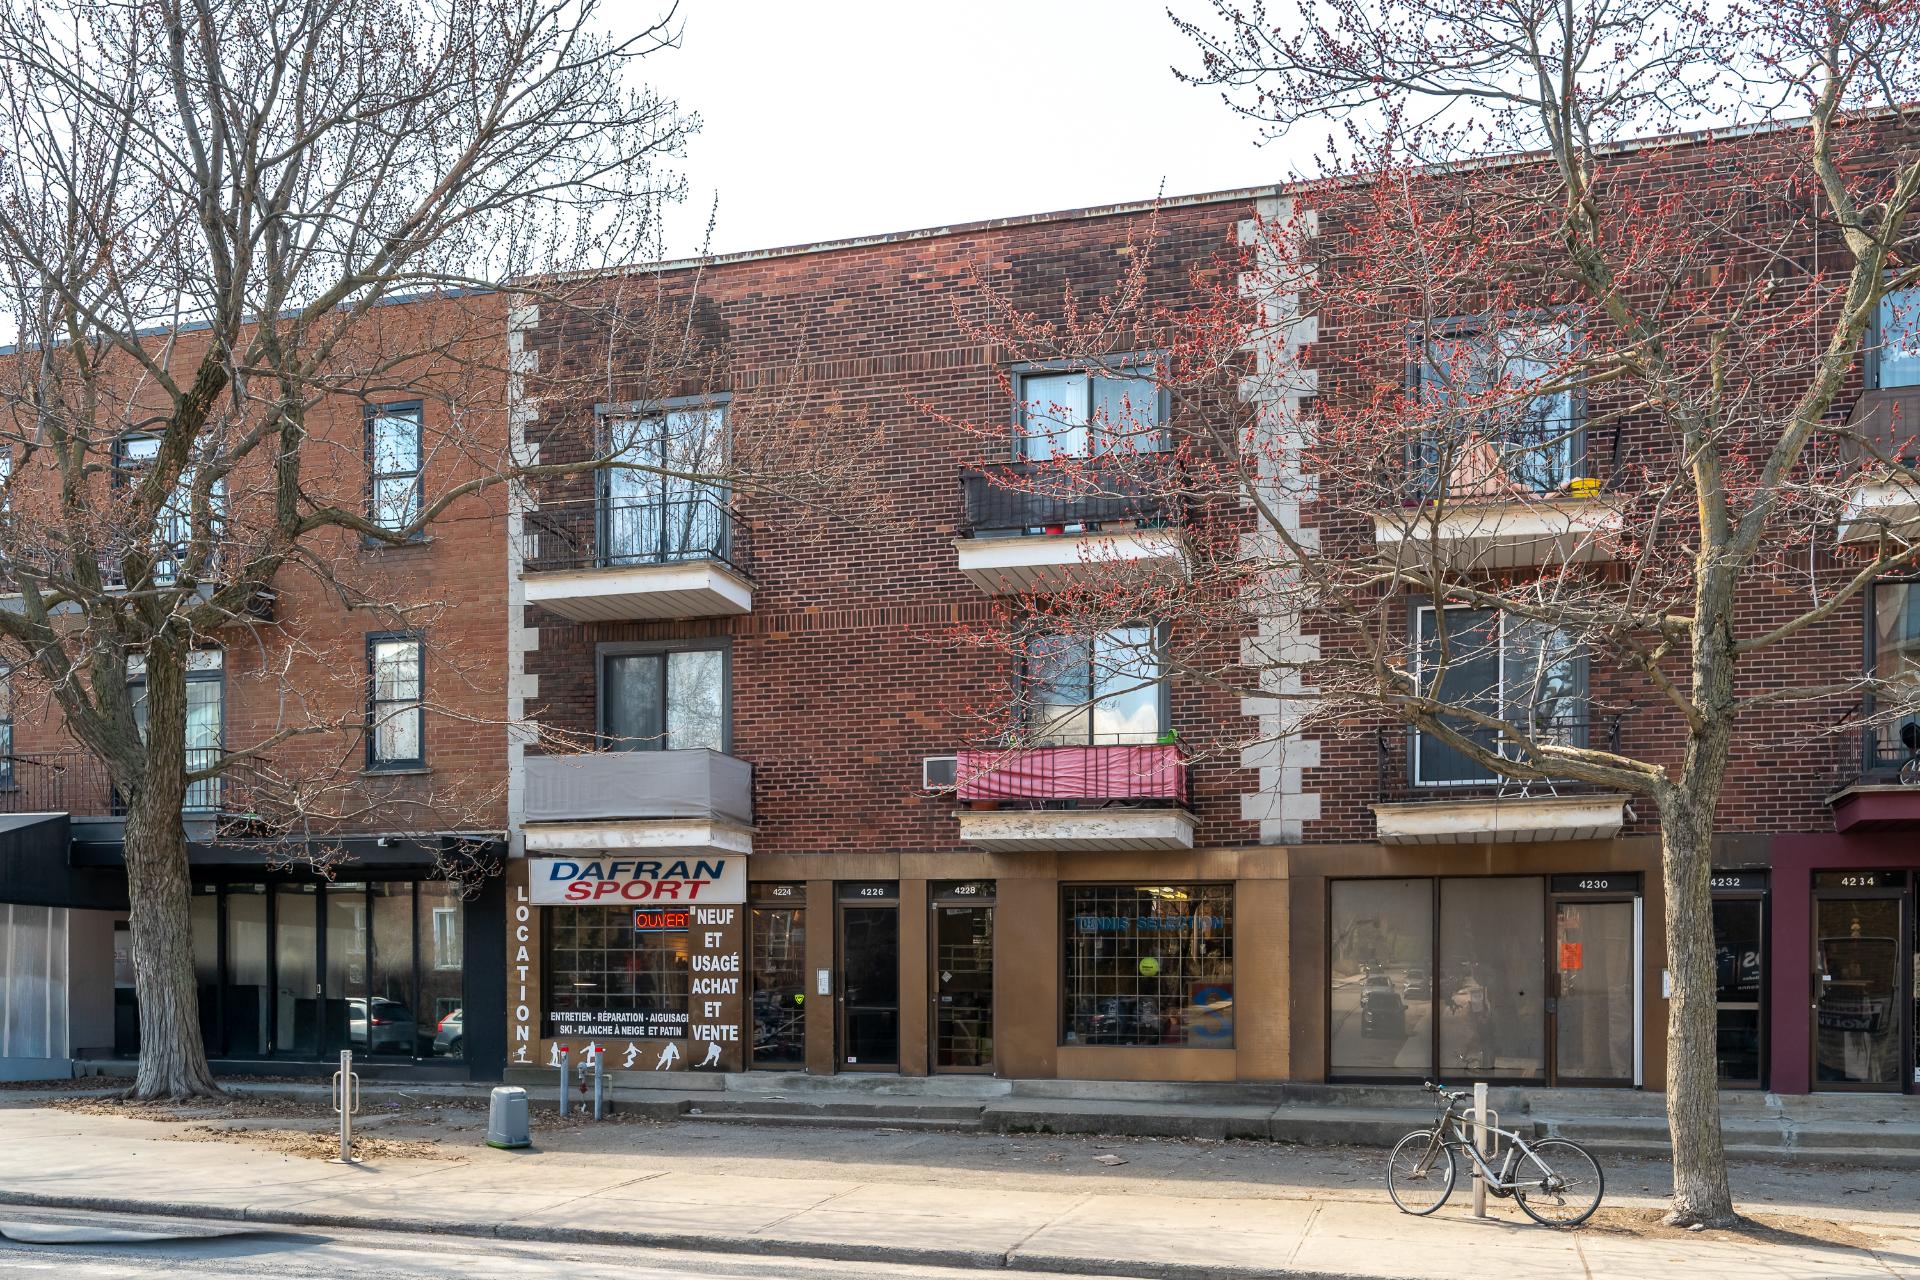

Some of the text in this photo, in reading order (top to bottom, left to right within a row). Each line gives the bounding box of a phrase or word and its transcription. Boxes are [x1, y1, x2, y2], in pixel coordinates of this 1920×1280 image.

[549, 860, 726, 881] DAFRAN
[1579, 880, 1609, 889] 4230
[1710, 877, 1741, 887] 4232
[1841, 877, 1875, 886] 4234
[564, 880, 711, 901] SPORT
[772, 888, 792, 896] 4224
[860, 888, 884, 896] 4226
[954, 886, 976, 895] 4228
[697, 908, 735, 925] NEUF
[704, 932, 723, 948] ET
[515, 885, 530, 1041] LOCATION
[692, 952, 739, 972] USAGÉ
[692, 978, 739, 994] ACHAT
[550, 1012, 592, 1021] ENTRETIEN
[597, 1010, 644, 1022] RÉPARATION
[704, 1001, 722, 1018] ET
[559, 1025, 573, 1034] SKI
[578, 1025, 613, 1035] PLANCHE
[614, 1024, 620, 1035] À
[621, 1026, 645, 1036] NEIGE
[648, 1026, 659, 1036] ET
[660, 1026, 682, 1036] PATIN
[692, 1024, 739, 1041] VENTE
